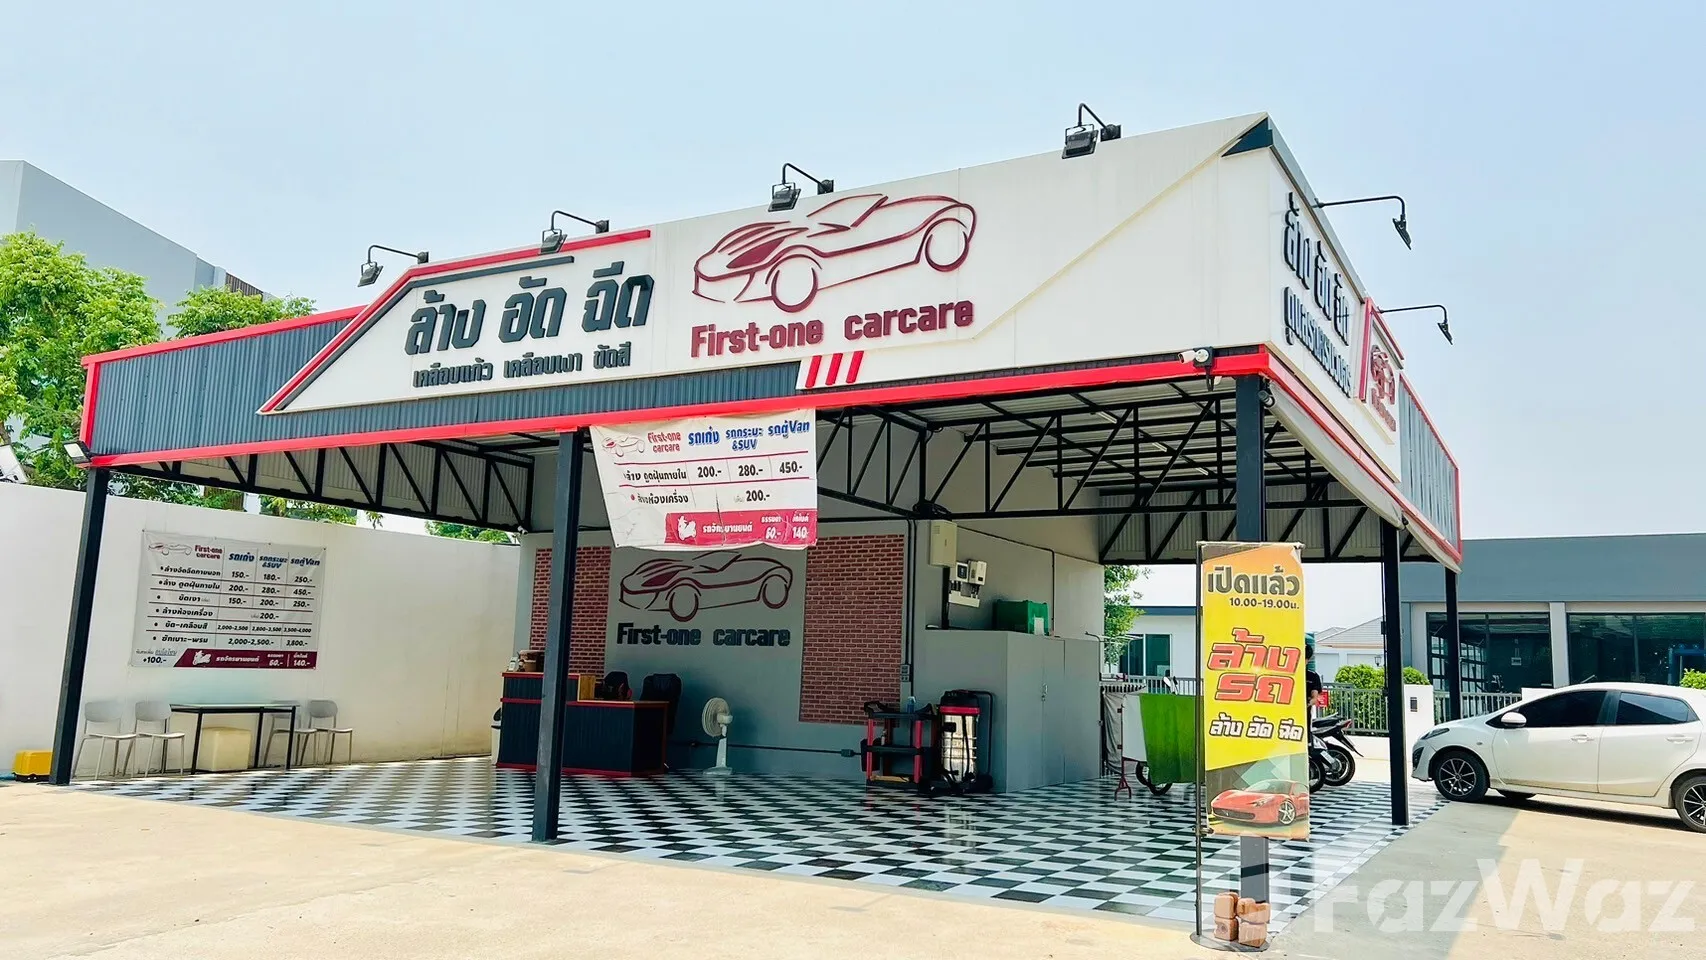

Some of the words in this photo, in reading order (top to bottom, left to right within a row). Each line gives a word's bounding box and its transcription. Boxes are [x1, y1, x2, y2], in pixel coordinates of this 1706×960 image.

[404, 289, 487, 355] ล้าง
[499, 276, 567, 343] อัด
[581, 261, 654, 333] ฉีด
[690, 320, 824, 357] First-one
[844, 300, 973, 340] carcare
[413, 358, 493, 387] เคลือบแก้ว
[503, 352, 582, 378] เคลือบเงา
[594, 341, 631, 369] ขัดสี
[648, 431, 681, 444] First-one
[725, 428, 763, 440] รถกระบะ
[653, 443, 681, 453] carcare
[732, 439, 757, 450] &SUV
[697, 467, 722, 478] 200.-
[738, 465, 763, 477] 280.-
[779, 461, 803, 474] 450.-
[644, 468, 687, 484] ดูดฝุ่นภายใน
[746, 489, 770, 501] 200.-
[194, 545, 223, 555] First-one
[231, 571, 250, 579] 150.-
[263, 573, 281, 581] 180.-
[1207, 565, 1300, 596] เปิดแล้ว
[163, 579, 176, 587] ล้าง
[178, 581, 220, 591] ดูดฝุ่นภายใน
[228, 584, 248, 592] 200.-
[261, 586, 281, 594] 280.-
[293, 587, 311, 596] 450.-
[229, 597, 247, 605] 150.-
[260, 598, 279, 606] 200.-
[293, 600, 310, 608] 250.-
[1229, 598, 1300, 609] 10.00-19.00น.
[162, 607, 213, 617] ล้างห้องเครื่อง
[259, 612, 279, 620] 200.-
[616, 622, 701, 645] First-one
[713, 627, 791, 647] carcare
[227, 638, 275, 647] 2,000-2,500.-
[1207, 627, 1301, 673] ล้าง
[293, 659, 310, 667] 140.-
[1215, 672, 1295, 704] รถ
[1209, 712, 1244, 737] ล้าง
[1246, 715, 1274, 739] อัด
[1278, 718, 1304, 742] ฉีด
